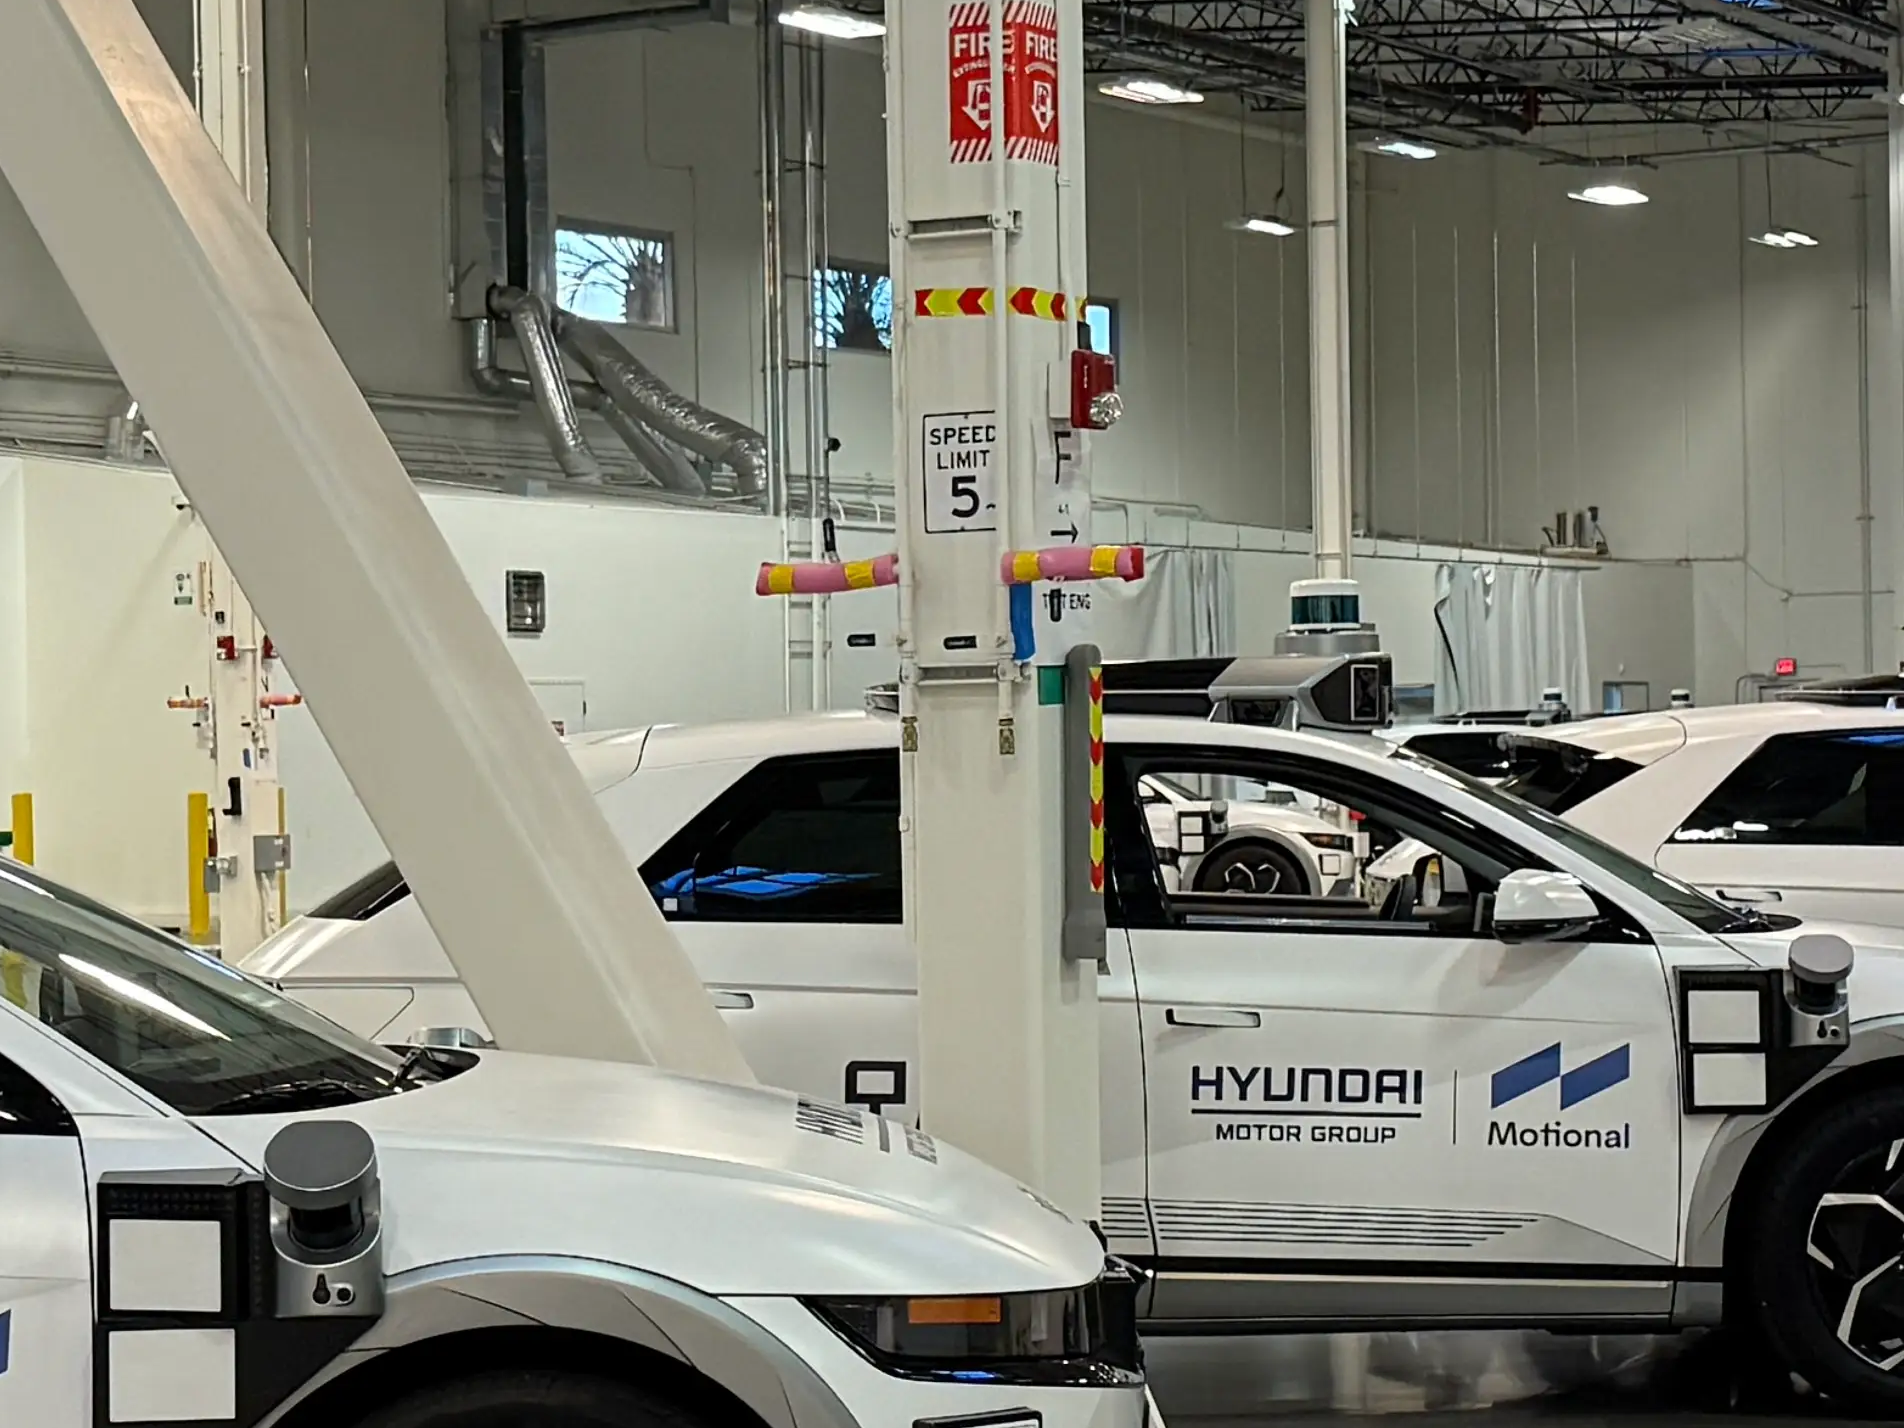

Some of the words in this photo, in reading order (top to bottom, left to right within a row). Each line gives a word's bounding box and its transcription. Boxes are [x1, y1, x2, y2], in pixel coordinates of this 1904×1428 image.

[936, 449, 991, 470] LIMIT
[951, 475, 980, 518] 5
[1192, 1065, 1423, 1105] HYUNDAI
[1215, 1123, 1301, 1143] MOTOR
[1310, 1124, 1398, 1145] GROUP
[1487, 1120, 1630, 1149] Motional
